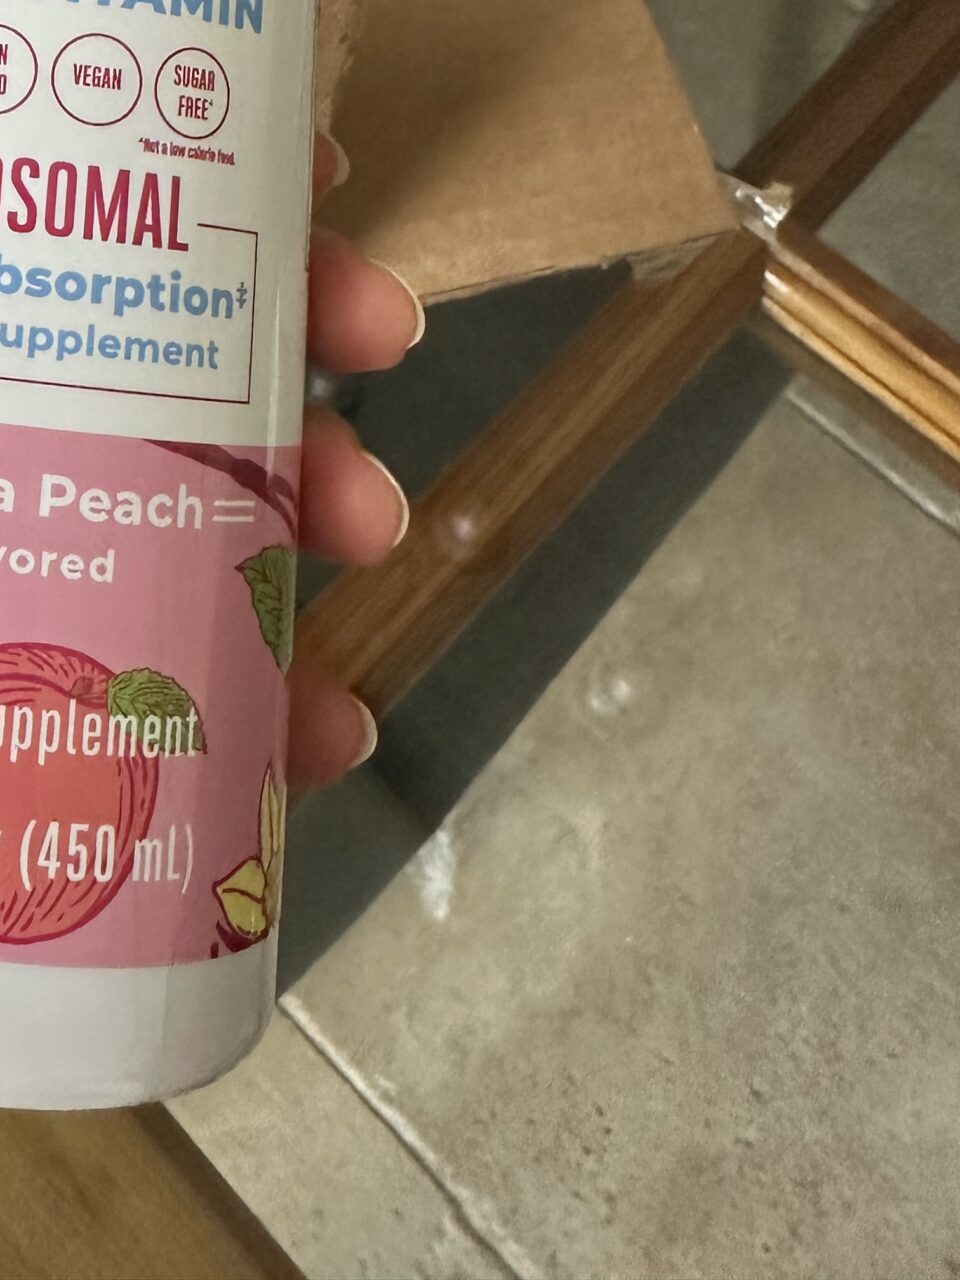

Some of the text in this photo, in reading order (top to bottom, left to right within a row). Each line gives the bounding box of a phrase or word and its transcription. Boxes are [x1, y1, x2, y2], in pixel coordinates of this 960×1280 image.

[73, 63, 122, 90] VEGAN
[173, 64, 215, 91] SUGAR
[161, 142, 168, 155] a
[170, 141, 186, 157] low
[40, 472, 203, 530] Peach
[19, 820, 117, 892] (450
[132, 824, 195, 895] mL)
